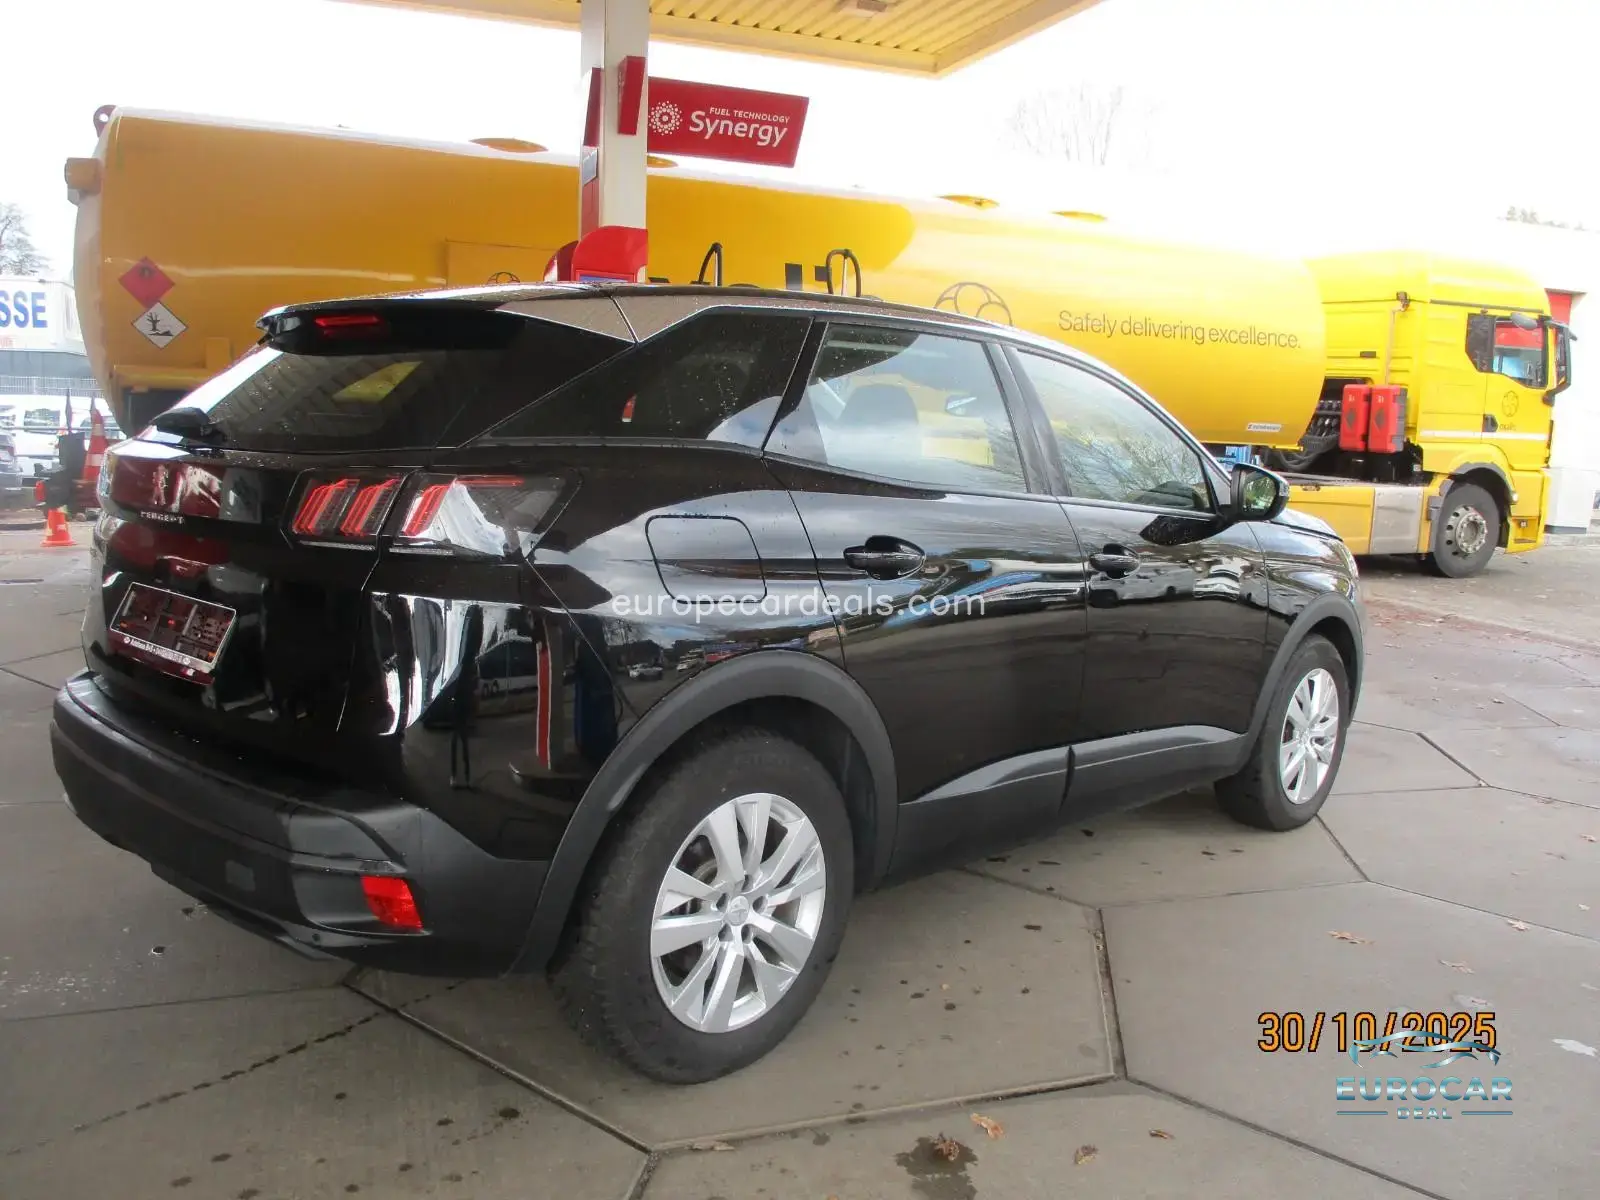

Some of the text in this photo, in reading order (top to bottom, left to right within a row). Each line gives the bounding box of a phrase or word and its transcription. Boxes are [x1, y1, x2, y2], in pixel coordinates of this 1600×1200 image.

[689, 110, 788, 147] Synergy
[709, 107, 791, 124] FUEL TECHNOLOGY
[1058, 310, 1301, 349] Safely delivering excellence.
